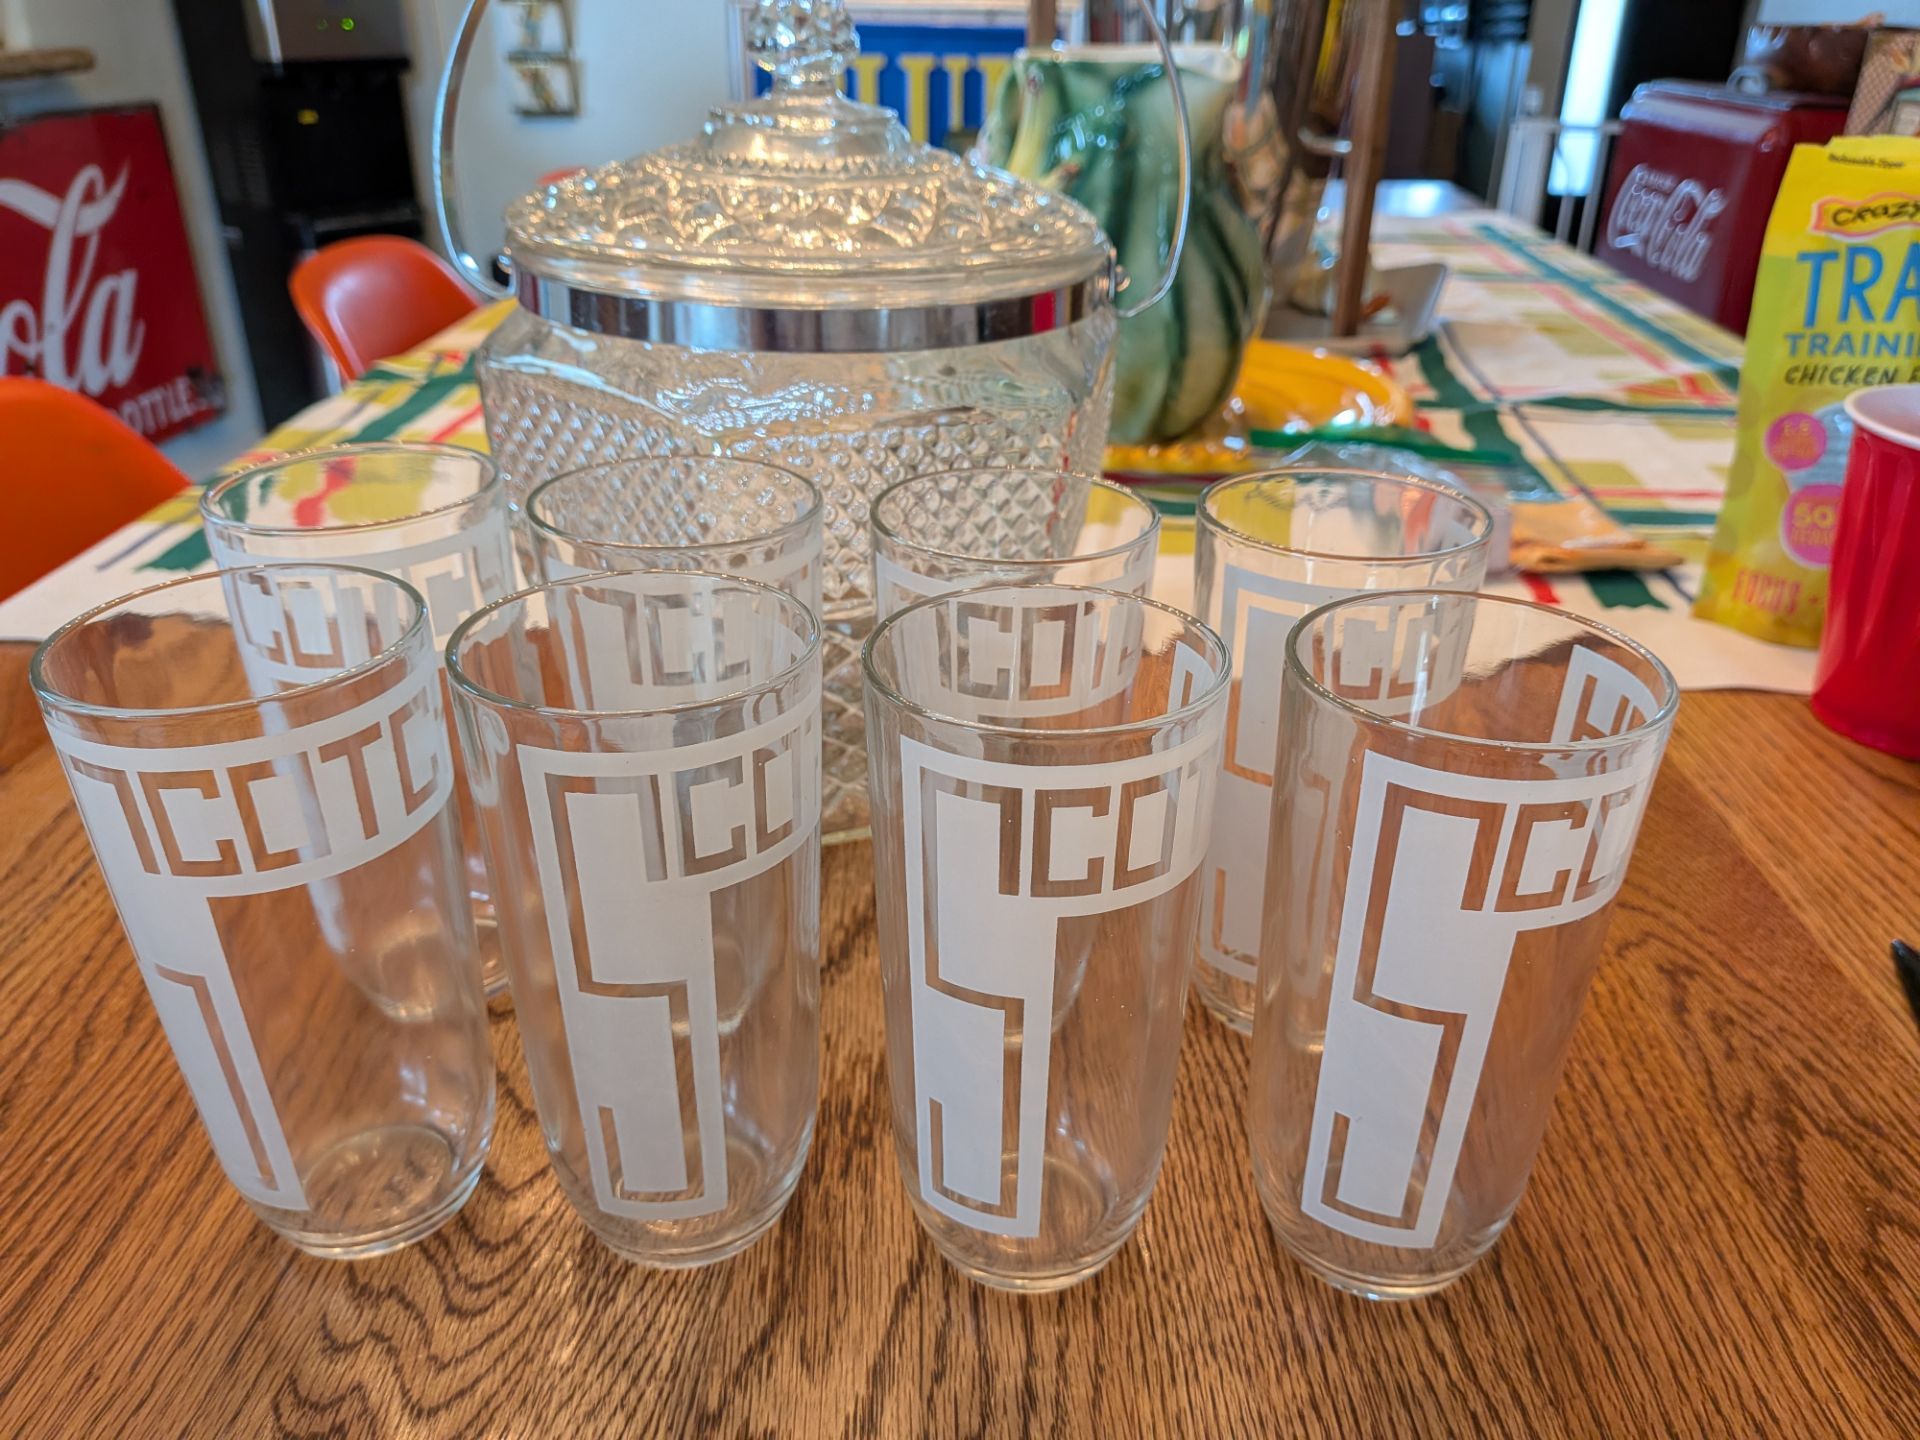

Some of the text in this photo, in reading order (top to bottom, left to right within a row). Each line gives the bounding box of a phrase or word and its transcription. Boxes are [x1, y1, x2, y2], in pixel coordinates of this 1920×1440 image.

[0, 162, 146, 397] ola
[1784, 332, 1920, 358] TRAINI
[1784, 364, 1898, 386] CHICKEN
